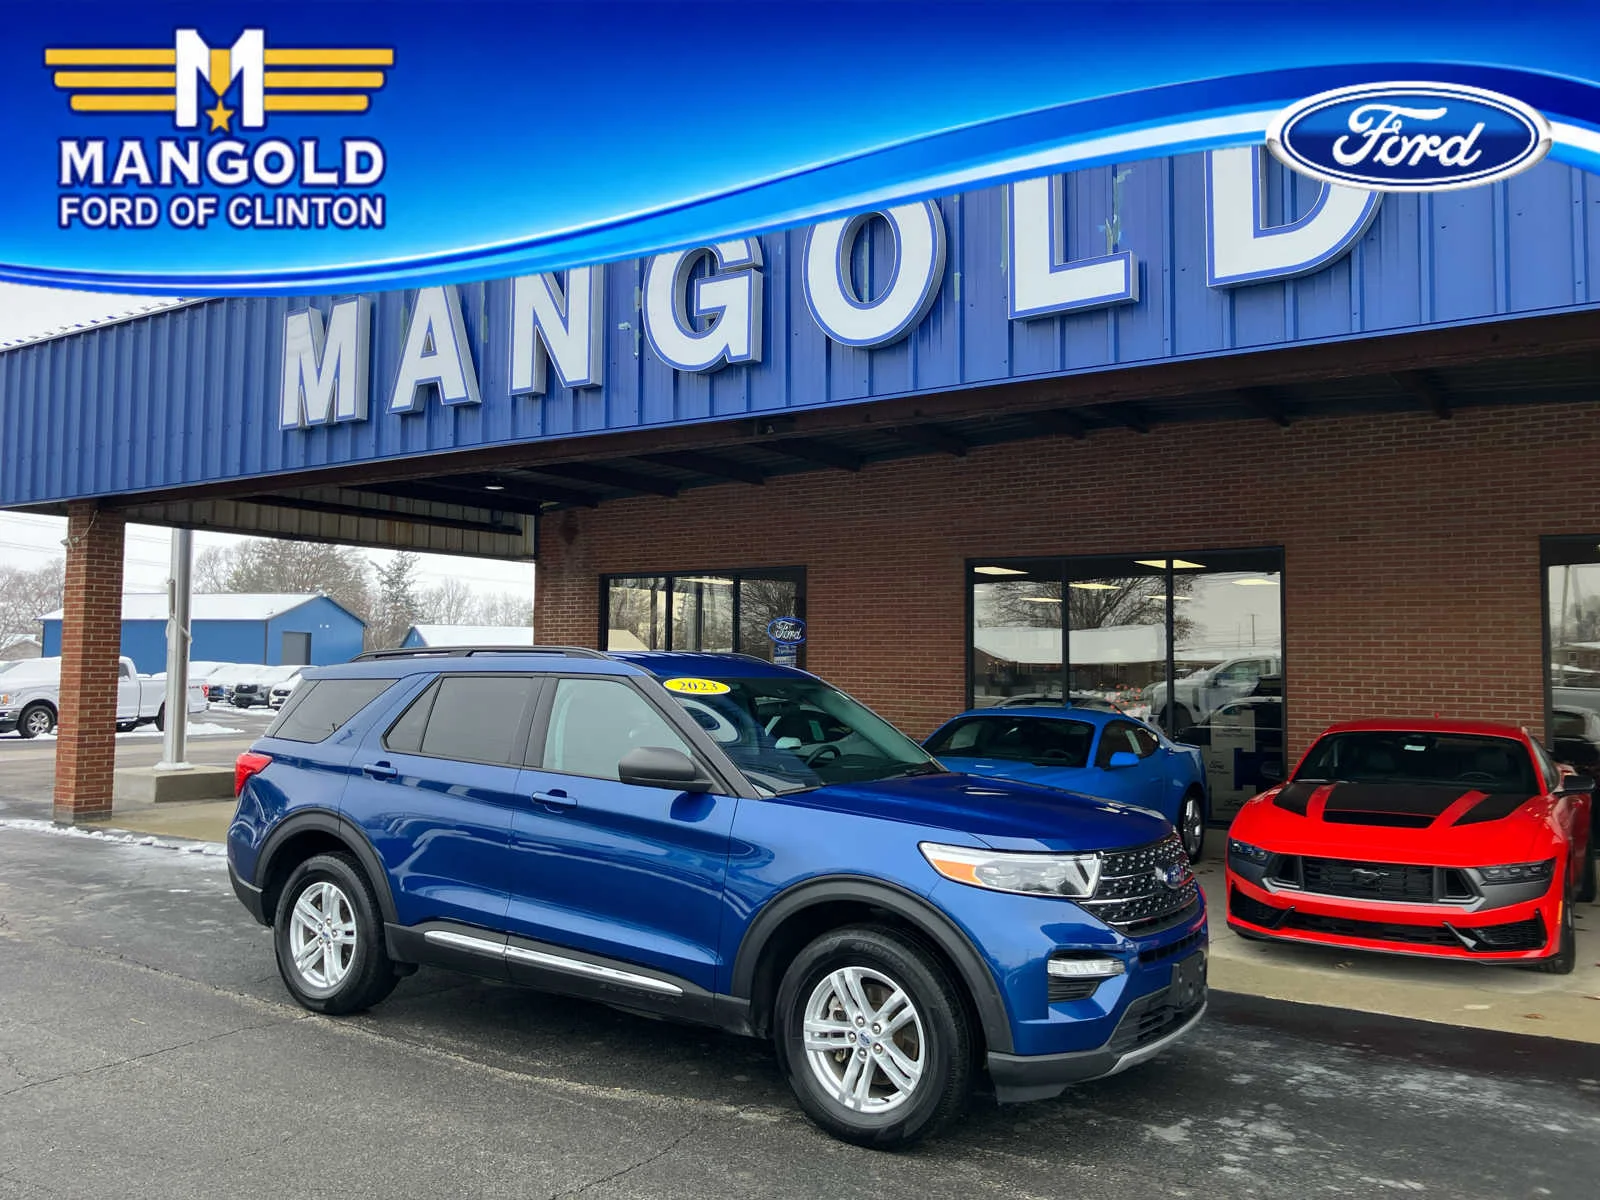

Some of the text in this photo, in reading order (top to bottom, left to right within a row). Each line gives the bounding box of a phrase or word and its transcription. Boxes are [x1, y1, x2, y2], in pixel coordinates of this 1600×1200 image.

[279, 143, 1384, 431] MANGOLD
[775, 620, 802, 640] Ford
[679, 680, 719, 691] 2023
